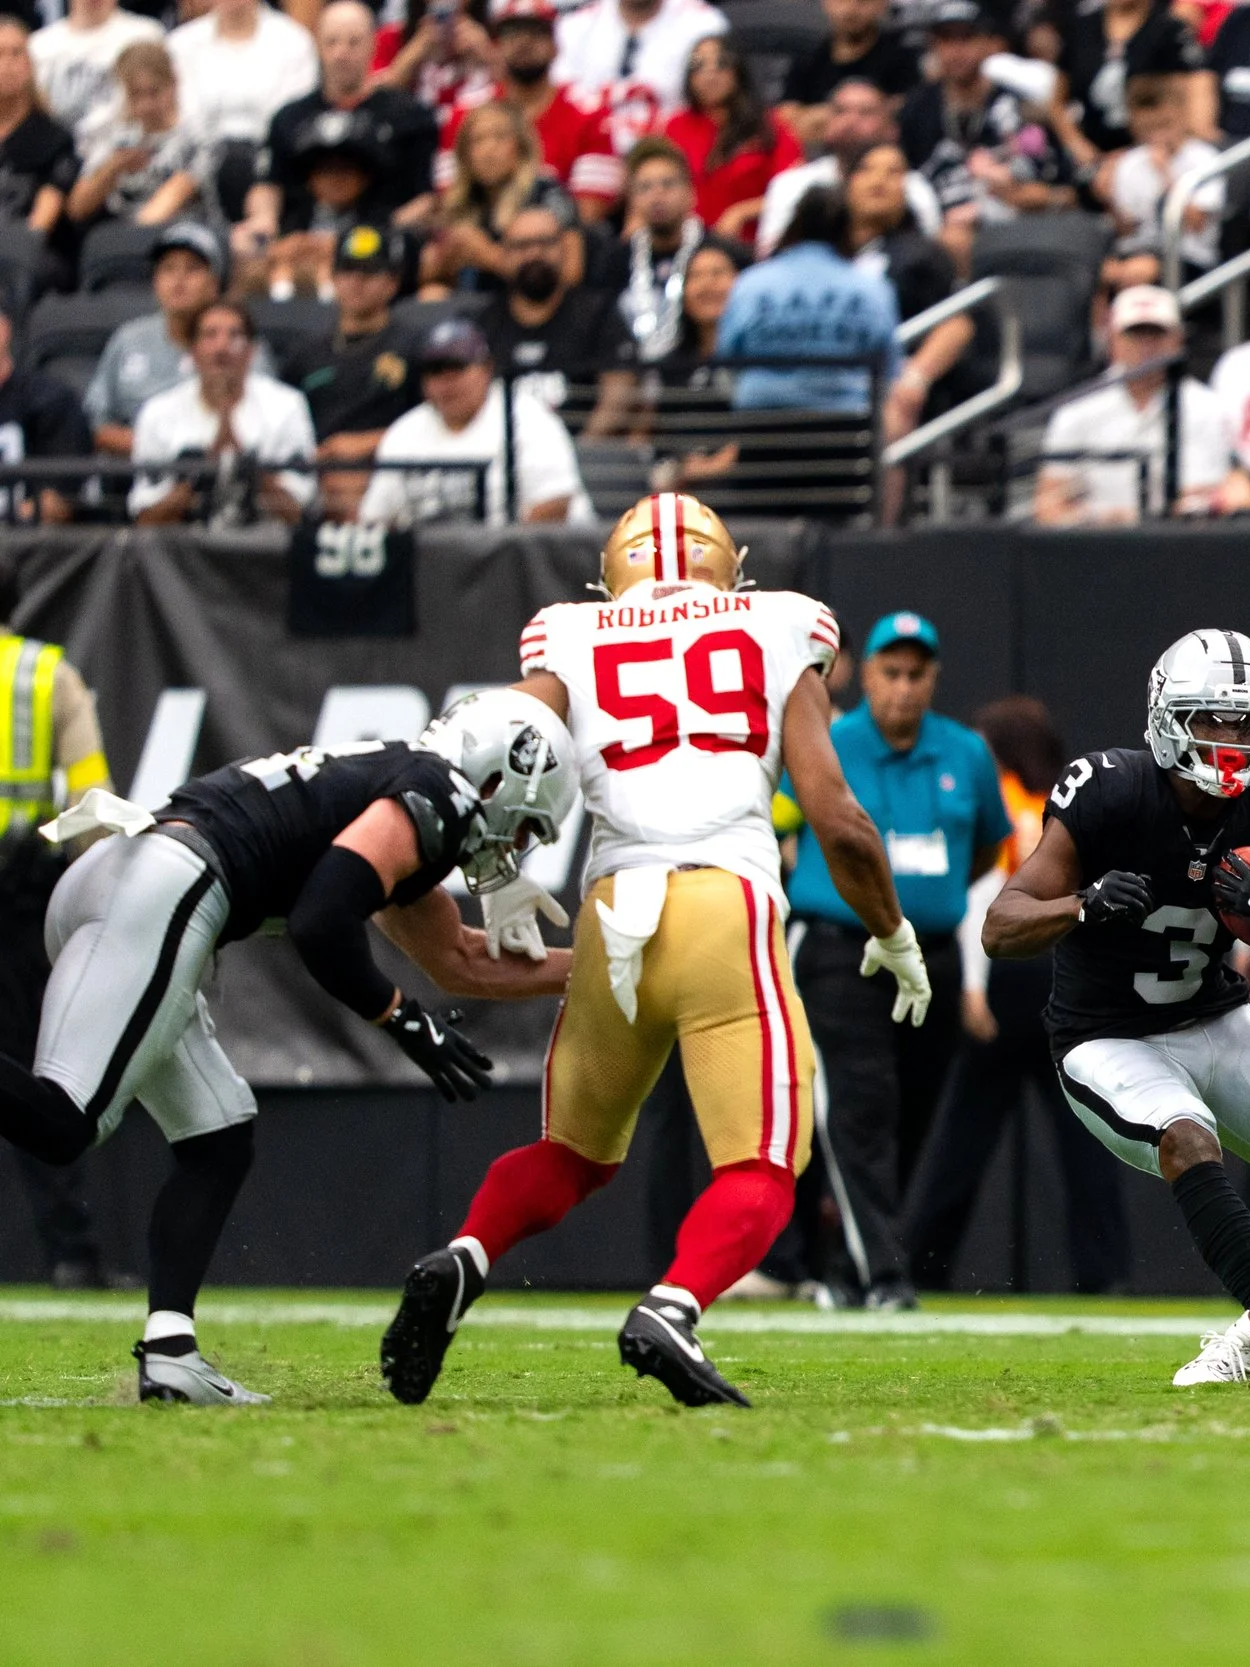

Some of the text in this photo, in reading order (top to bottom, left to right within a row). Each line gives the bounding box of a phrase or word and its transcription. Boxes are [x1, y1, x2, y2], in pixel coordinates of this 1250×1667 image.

[596, 595, 752, 631] ROBINSON
[592, 628, 770, 772] 59
[1050, 757, 1094, 811] 3
[1132, 903, 1220, 1005] 3
